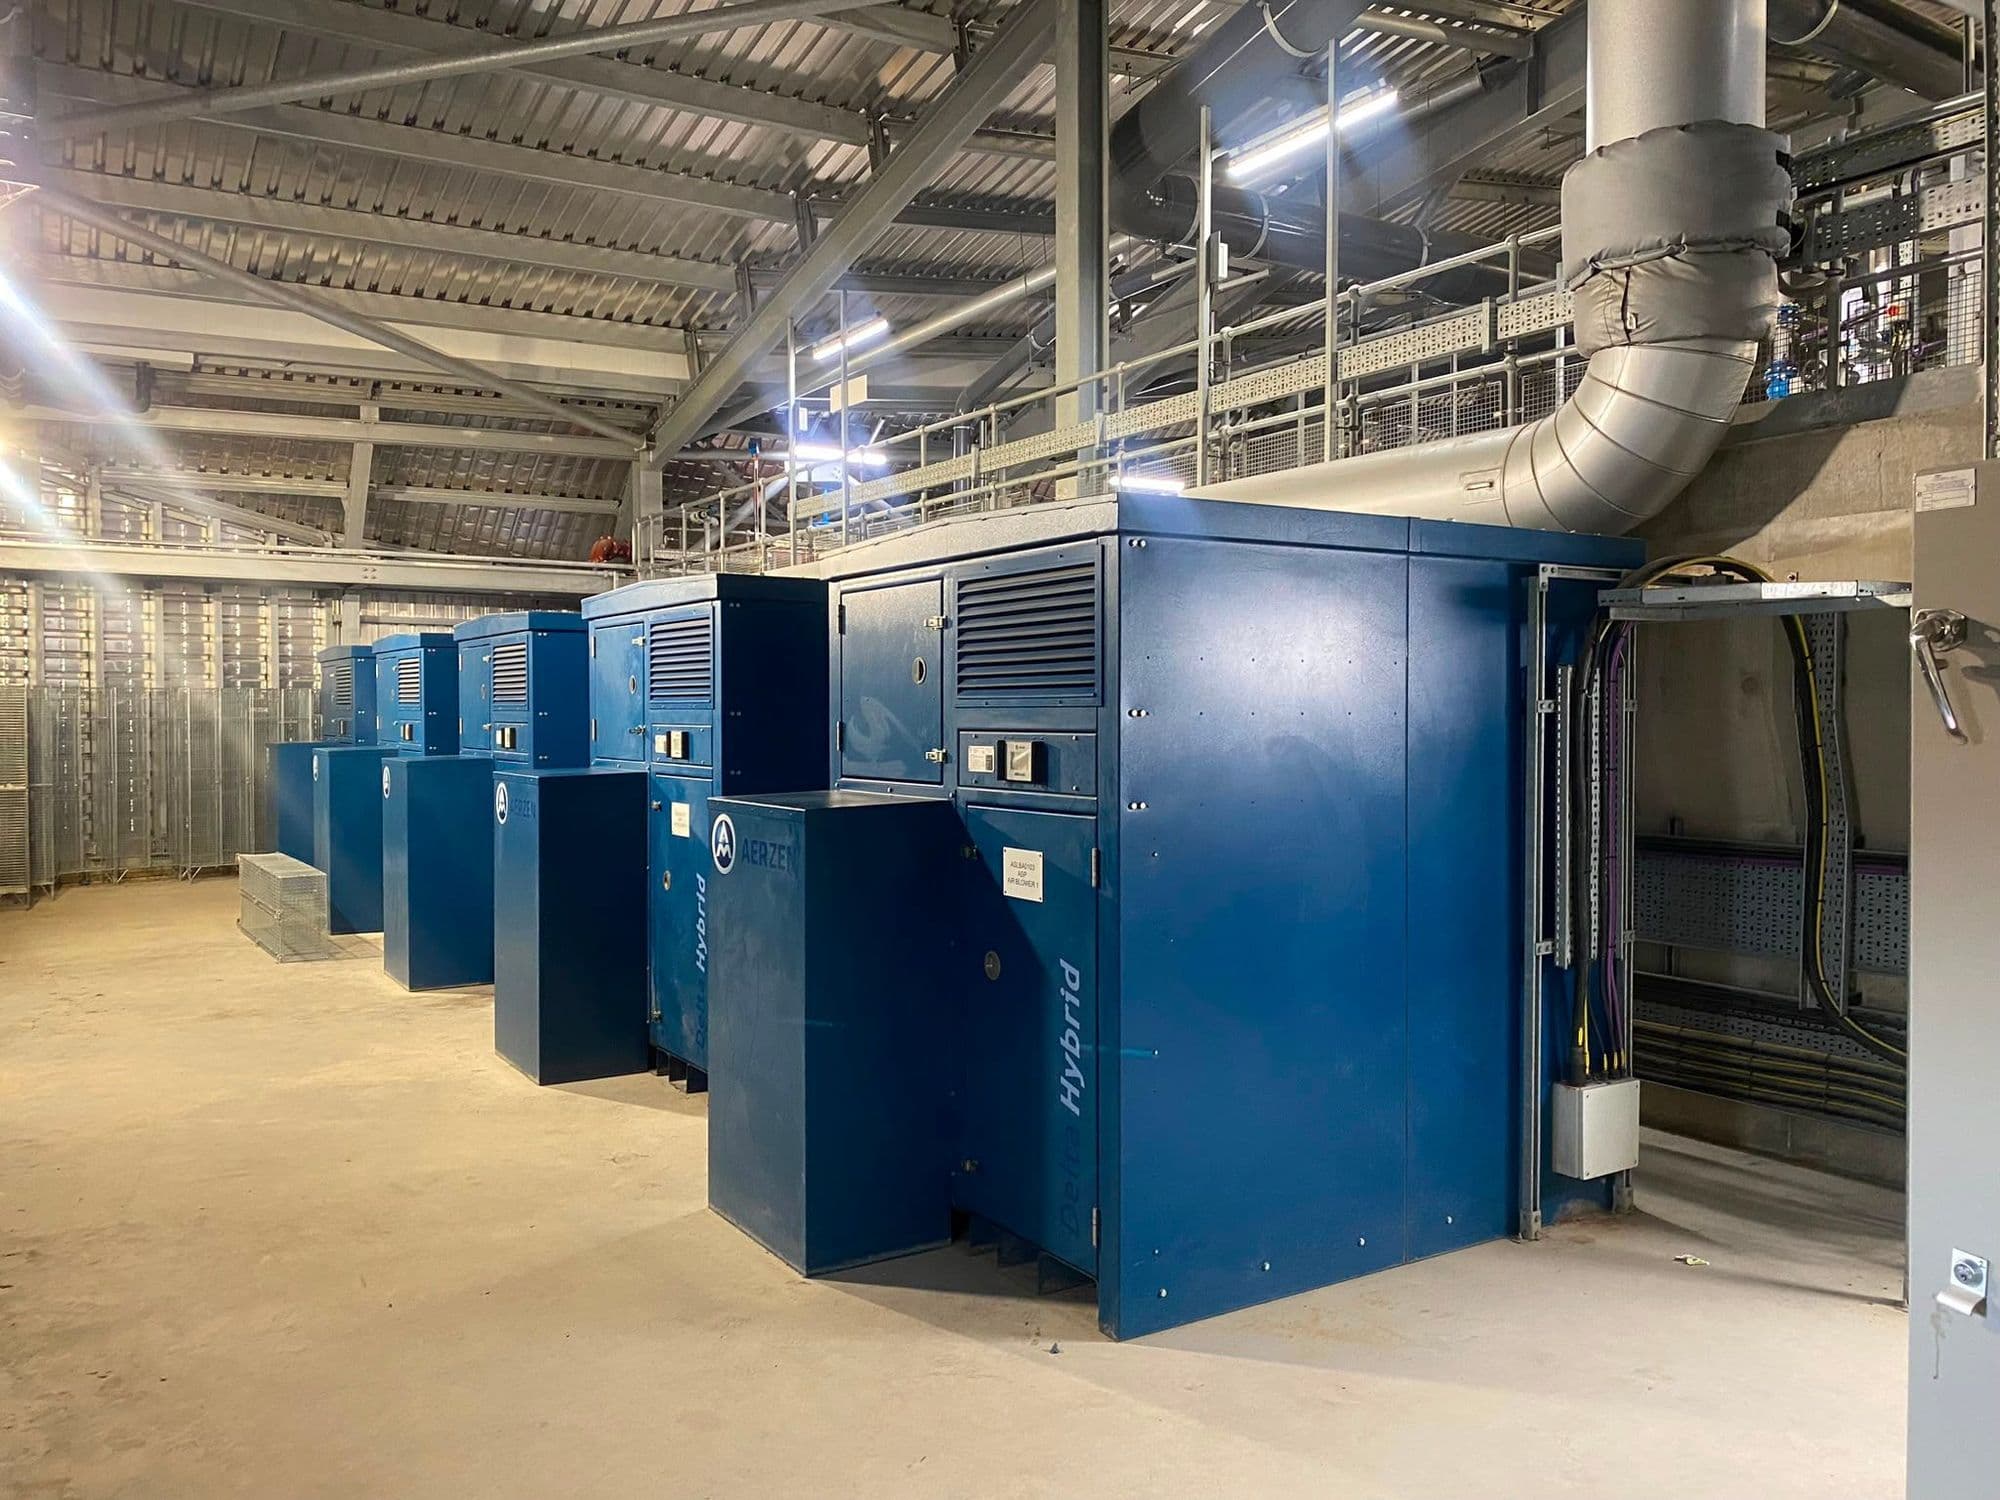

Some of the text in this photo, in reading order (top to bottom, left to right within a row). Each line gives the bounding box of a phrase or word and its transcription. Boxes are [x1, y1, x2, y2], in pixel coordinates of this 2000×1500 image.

[741, 838, 800, 872] AERZEN
[696, 873, 708, 973] Hybrid
[1060, 958, 1085, 1117] Hybrid
